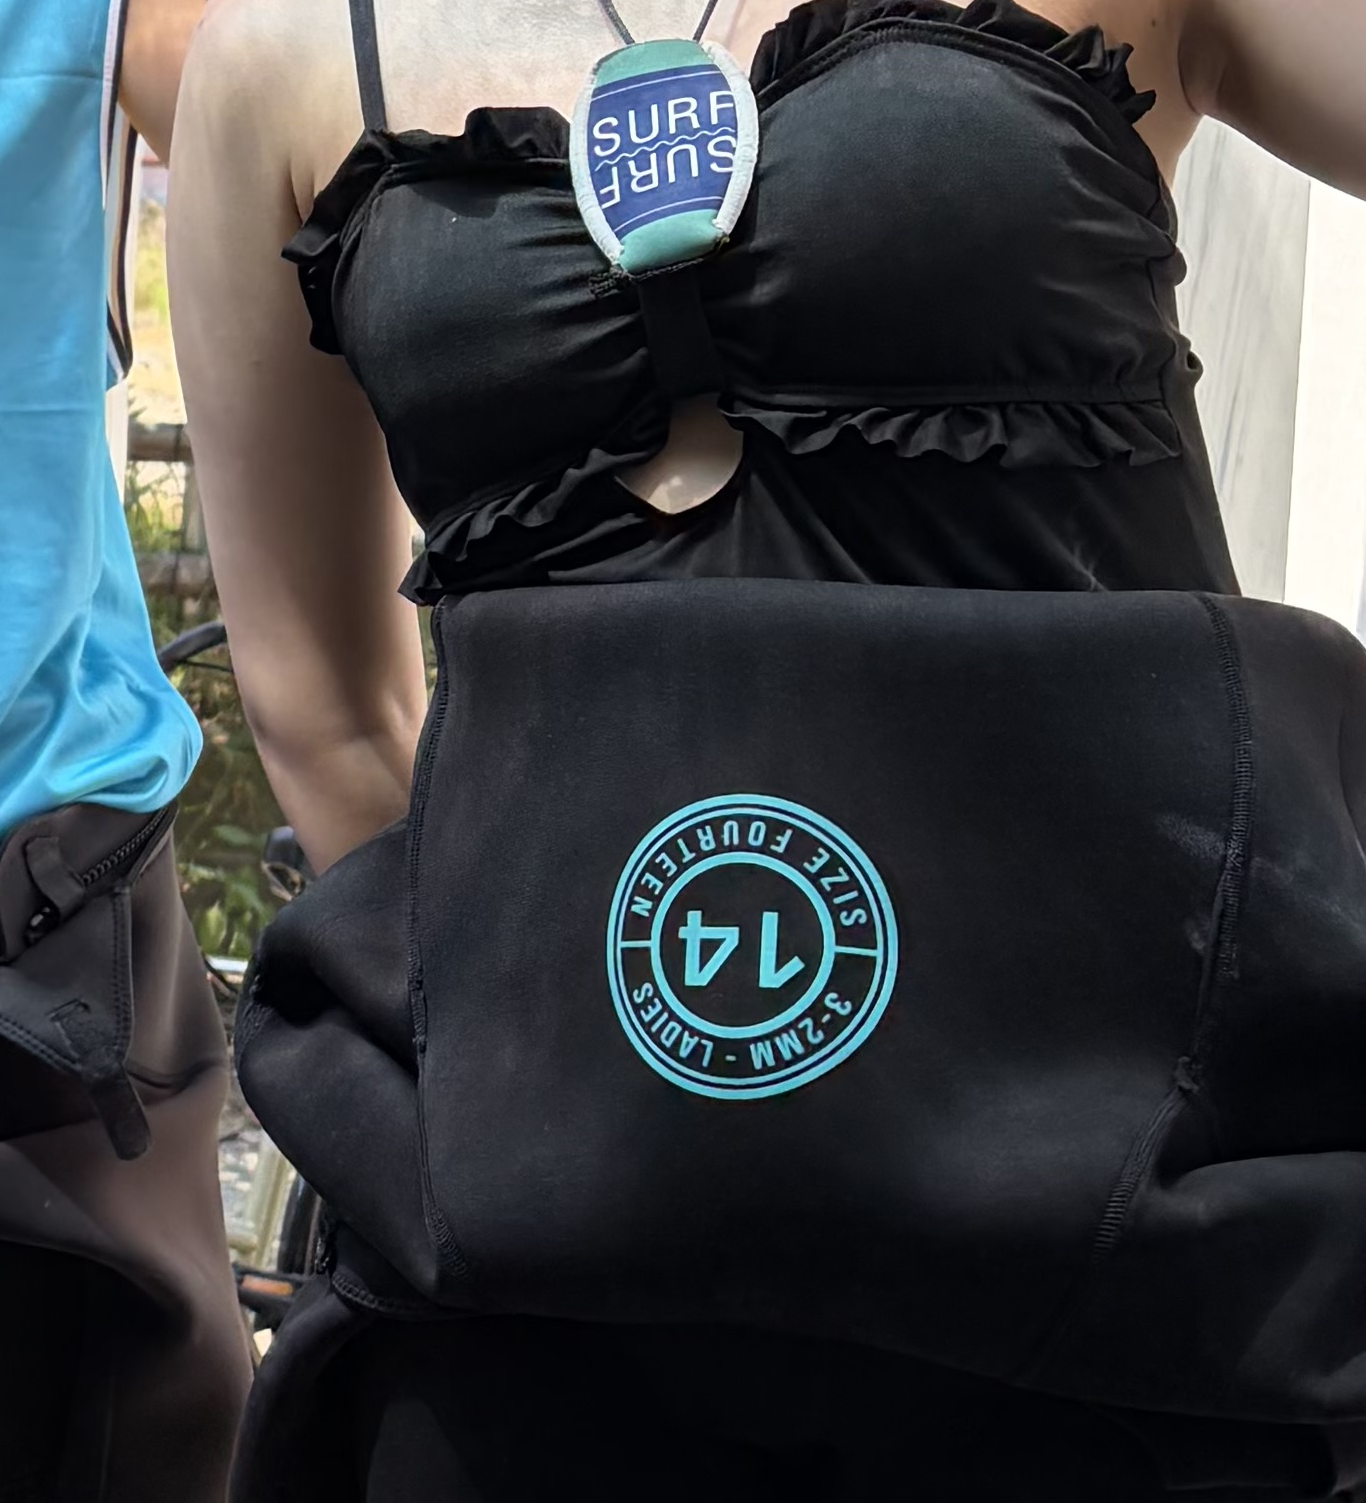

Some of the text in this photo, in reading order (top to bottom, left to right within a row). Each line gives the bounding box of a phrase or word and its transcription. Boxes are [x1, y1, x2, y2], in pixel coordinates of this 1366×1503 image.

[592, 90, 735, 157] SURF
[598, 134, 737, 209] SURF
[629, 819, 868, 930] SIZE FOURTEEN
[678, 909, 806, 989] 14
[632, 981, 715, 1068] LADIES
